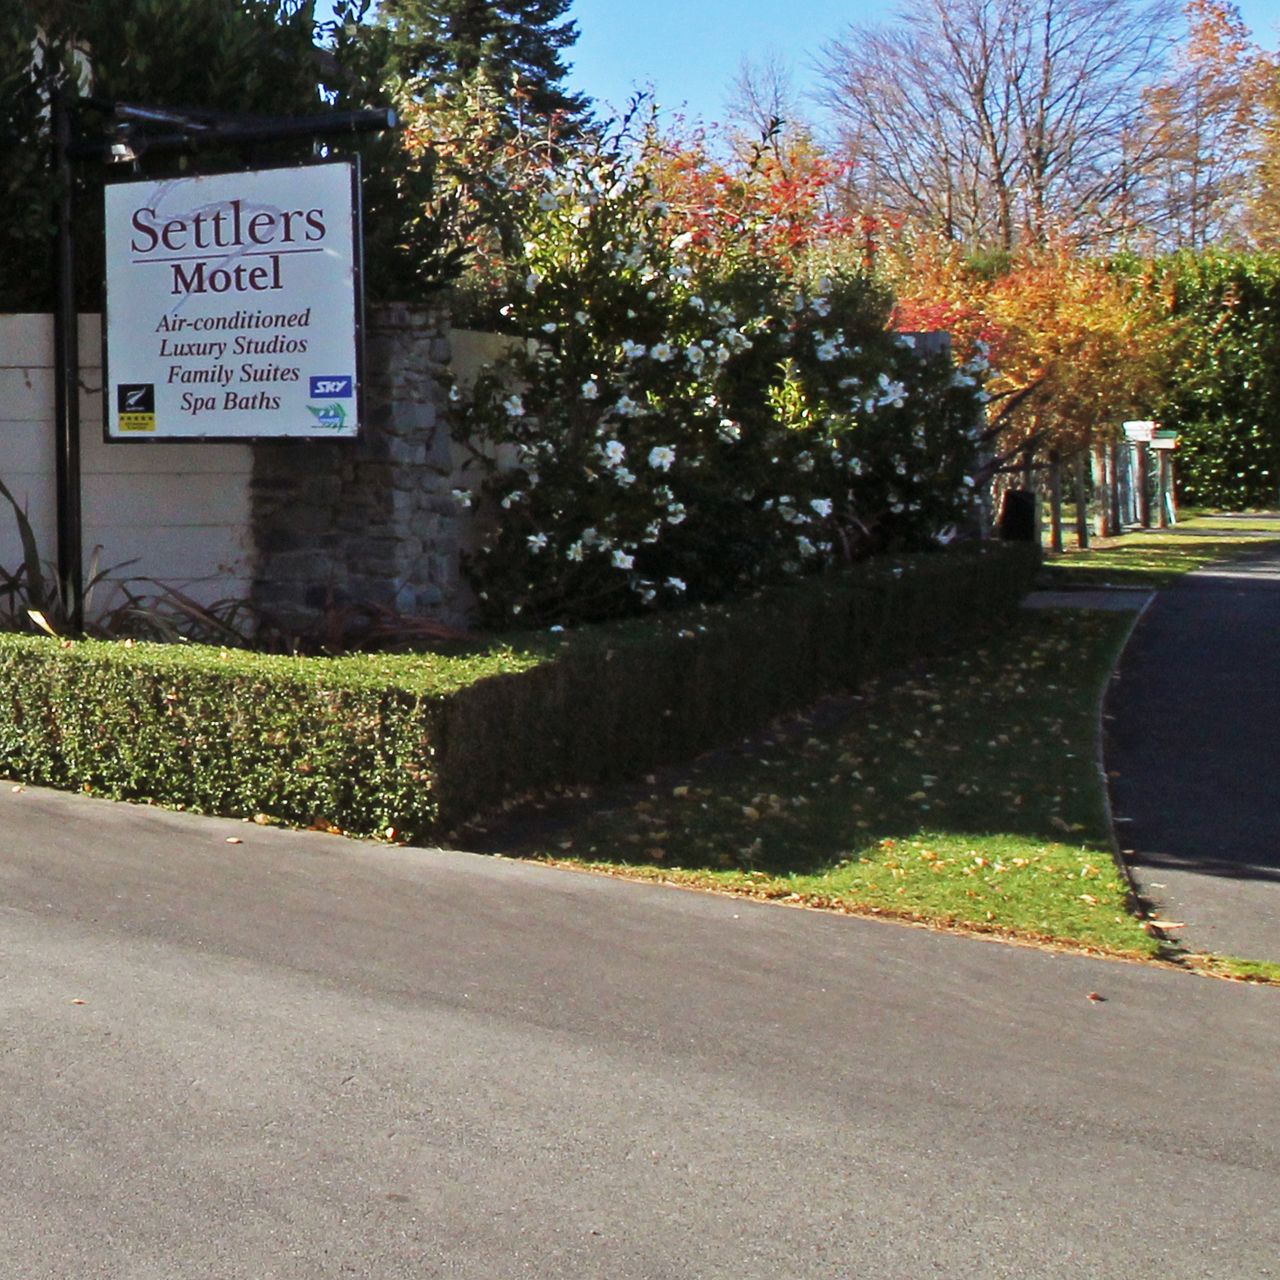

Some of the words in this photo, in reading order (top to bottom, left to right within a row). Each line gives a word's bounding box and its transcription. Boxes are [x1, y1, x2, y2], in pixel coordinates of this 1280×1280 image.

[131, 200, 326, 253] Settlers
[171, 255, 283, 294] Motel
[155, 308, 311, 332] Air-conditioned
[159, 338, 227, 360] Luxury
[233, 334, 308, 355] Studios
[167, 364, 234, 387] Family
[240, 363, 301, 382] Suites
[314, 381, 348, 393] SKY
[180, 391, 216, 415] Spa
[223, 391, 281, 410] Baths
